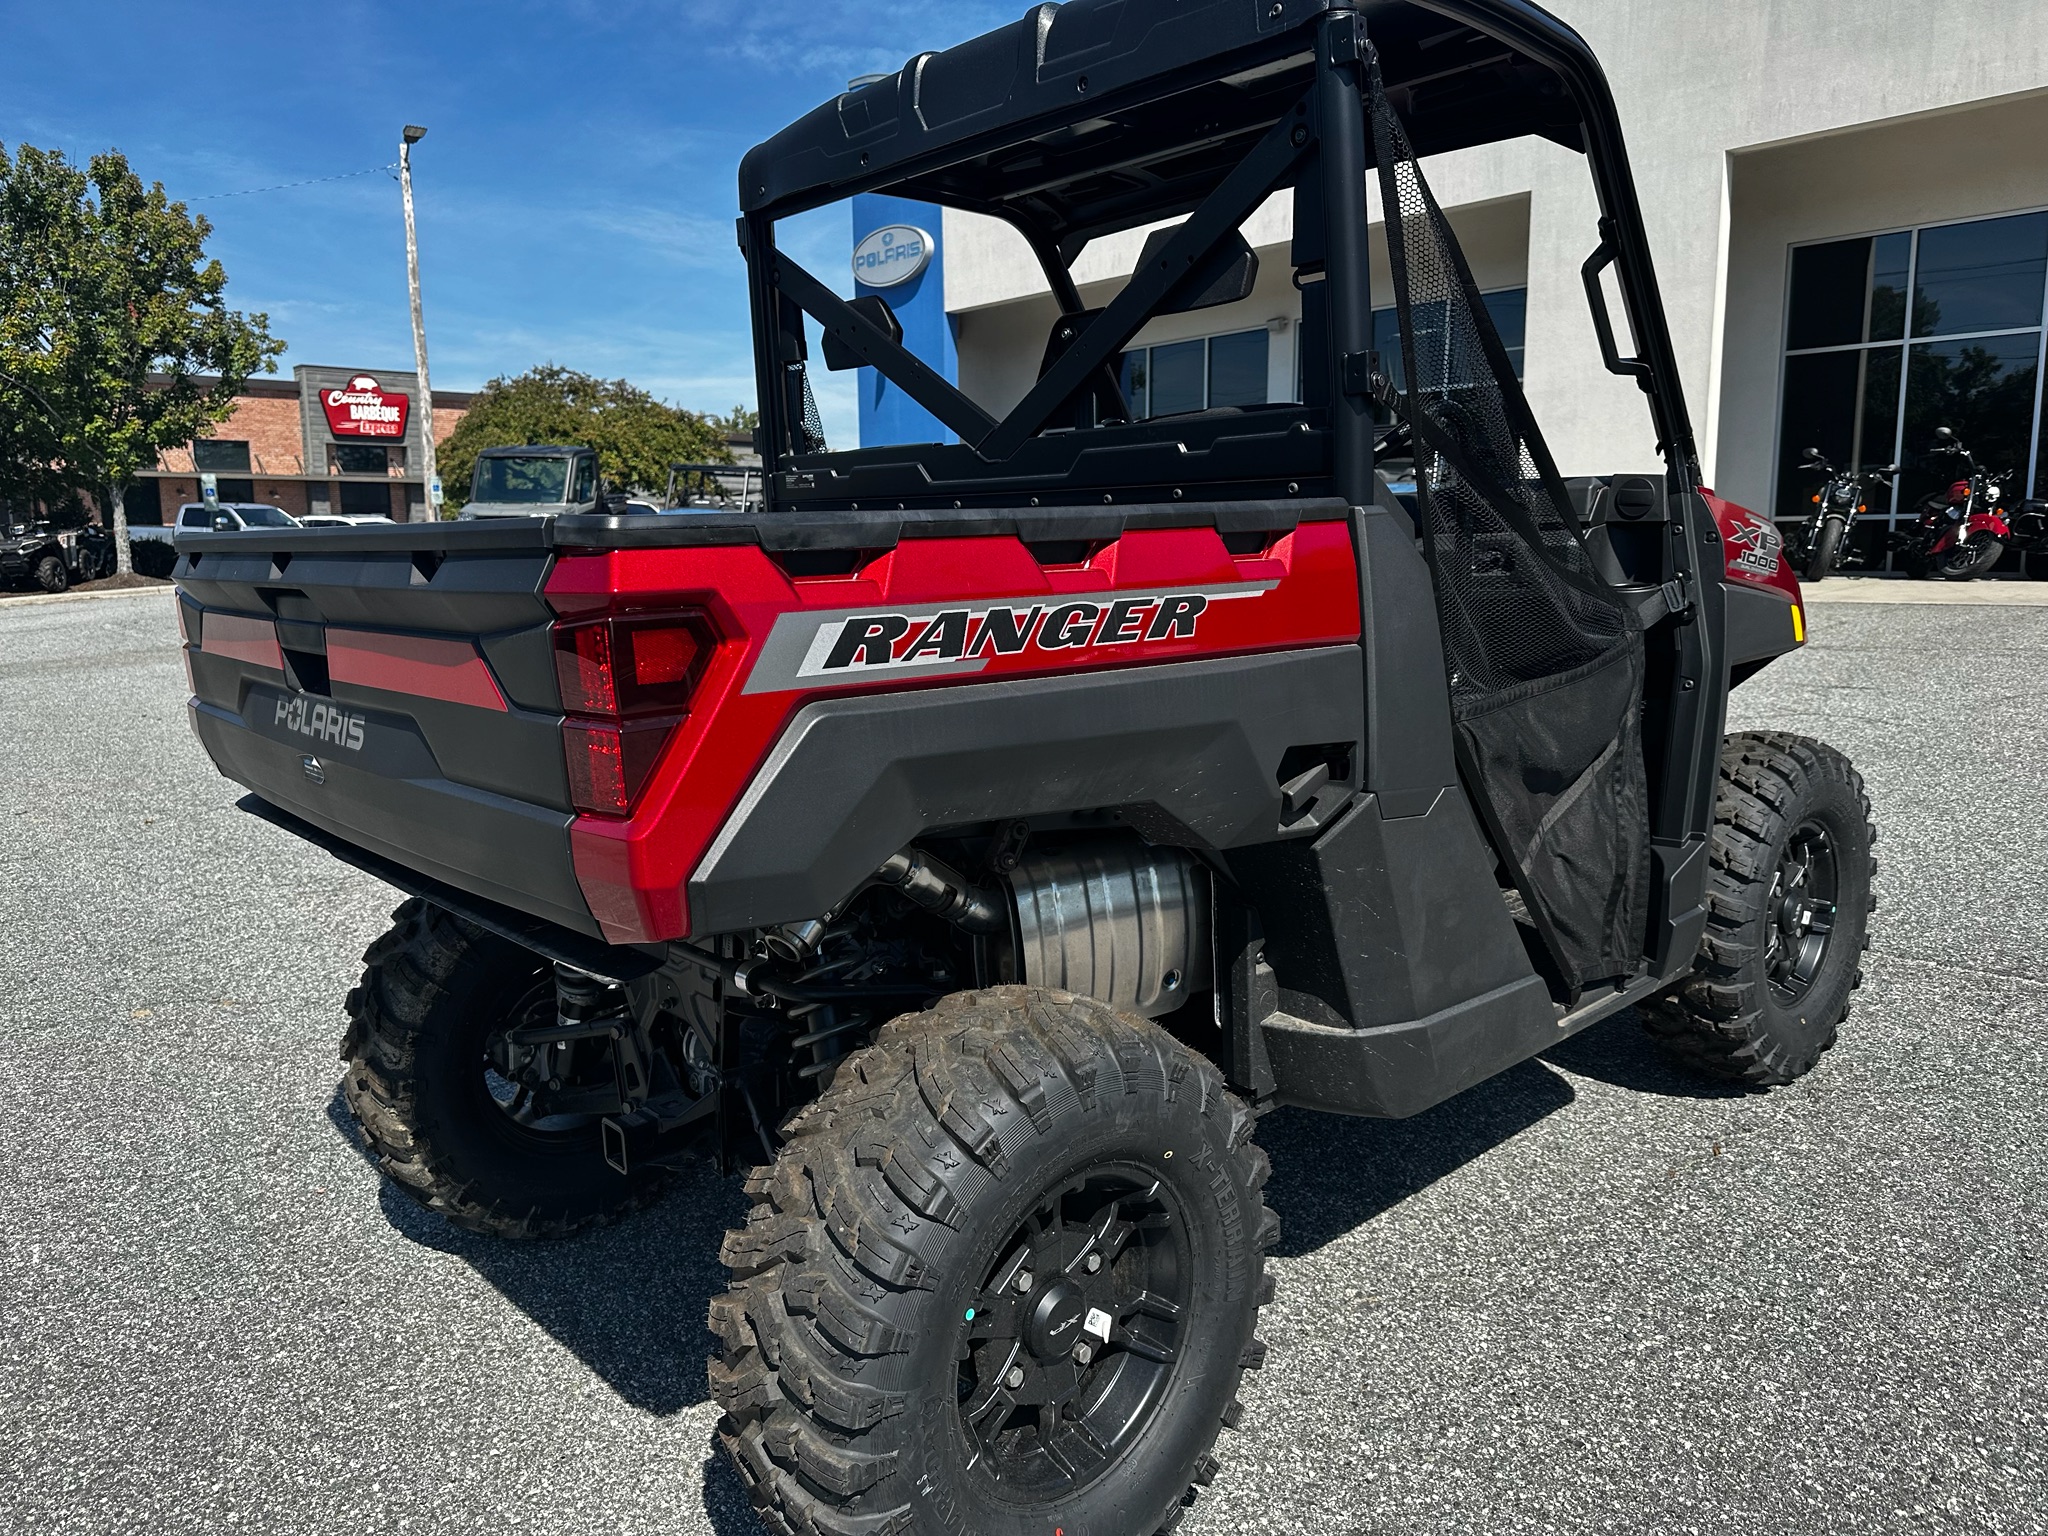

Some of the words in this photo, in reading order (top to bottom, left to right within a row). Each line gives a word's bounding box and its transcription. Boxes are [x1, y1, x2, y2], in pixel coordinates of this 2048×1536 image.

[855, 240, 921, 271] POLARIS
[328, 390, 383, 406] Country
[350, 405, 401, 422] BARBEQUE
[1726, 519, 1783, 552] XP
[1740, 549, 1780, 573] 1000
[821, 594, 1208, 670] RANGER
[274, 694, 366, 751] POLARIS
[1189, 1139, 1247, 1302] X-TERRAIN
